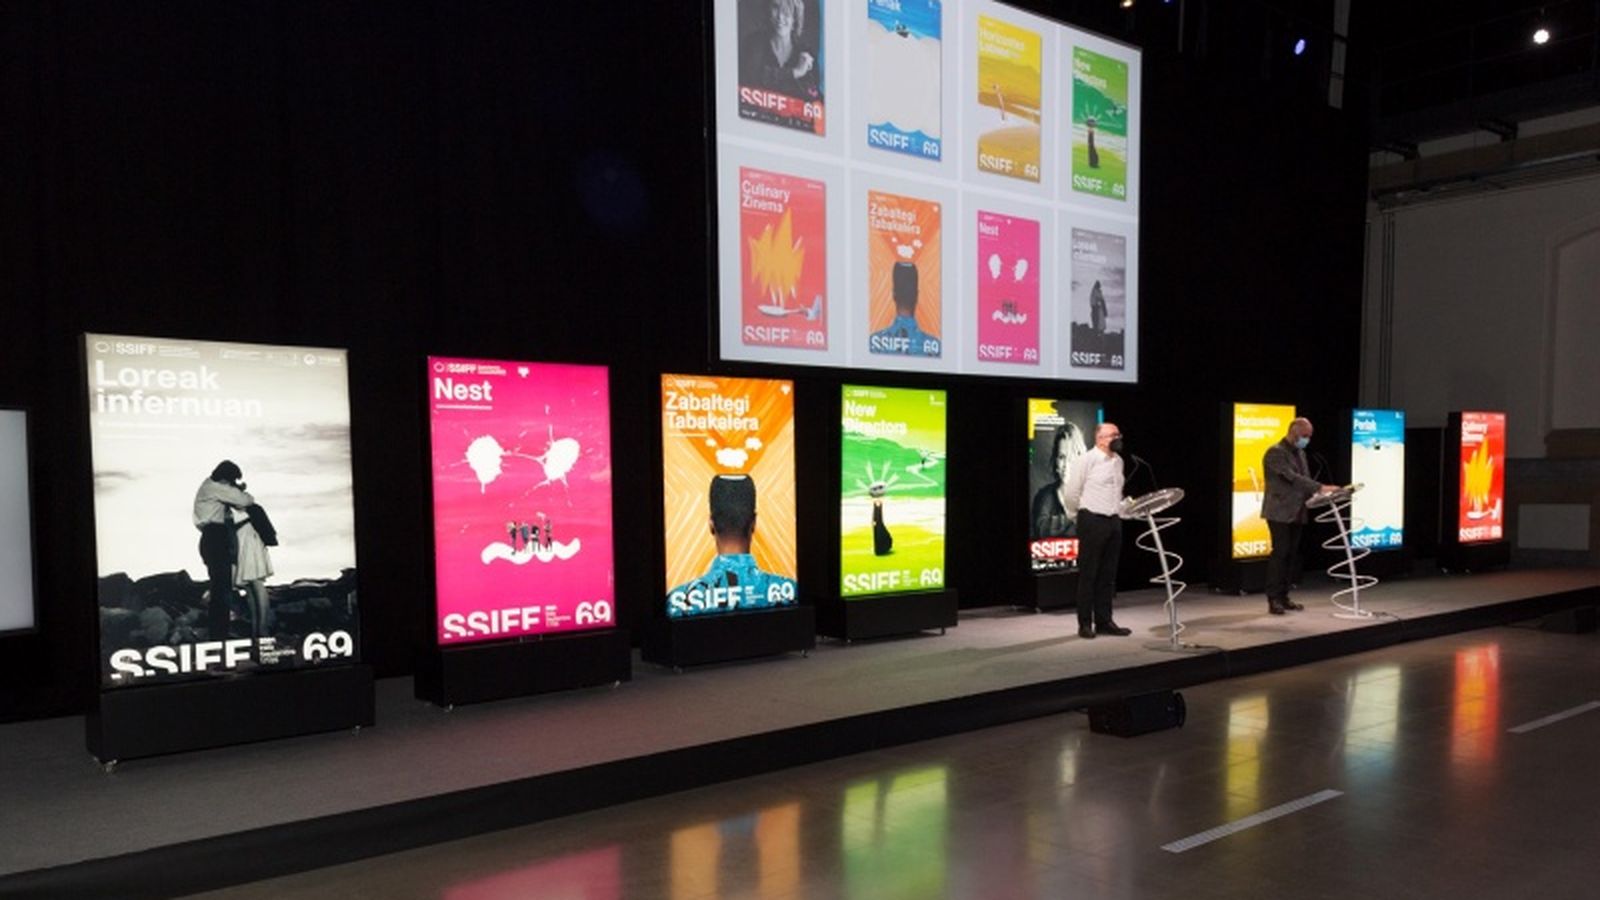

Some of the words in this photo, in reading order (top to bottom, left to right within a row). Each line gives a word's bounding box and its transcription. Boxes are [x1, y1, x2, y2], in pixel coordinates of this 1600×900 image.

[741, 87, 787, 110] SSIFF
[803, 102, 821, 118] 69
[869, 128, 909, 149] SSIFF
[923, 141, 939, 156] 69
[980, 154, 1013, 173] SSIFF
[1024, 164, 1038, 178] 69
[742, 180, 790, 203] Culinary
[1073, 174, 1102, 191] SSIFF
[742, 193, 783, 213] Zinema
[869, 202, 917, 225] Zabaltegi
[869, 215, 920, 235] Tabakalera
[980, 222, 998, 236] Nest
[744, 325, 790, 343] SSIFF
[806, 330, 824, 345] 69
[871, 335, 910, 352] SSIFF
[923, 339, 939, 353] 69
[979, 344, 1012, 359] SSIFF
[1023, 347, 1037, 360] 69
[1072, 351, 1101, 365] SSIFF
[1111, 354, 1122, 367] 69
[95, 360, 220, 390] Loreak
[434, 377, 493, 401] Nest
[96, 388, 263, 418] infernuan
[665, 391, 750, 416] Zabaltegi
[843, 399, 877, 417] New
[666, 411, 760, 431] Tabakalera
[1352, 533, 1381, 549] SSIFF
[1389, 531, 1402, 545] 69
[1459, 526, 1484, 541] SSIFF
[1031, 540, 1073, 558] SSIFF
[843, 569, 901, 593] SSIFF
[920, 567, 943, 587] 69
[669, 585, 742, 613] SSIFF
[767, 581, 794, 602] 69
[443, 606, 541, 639] SSIFF
[575, 599, 611, 625] 69
[109, 638, 252, 680] SSIFF
[303, 630, 353, 661] 69
